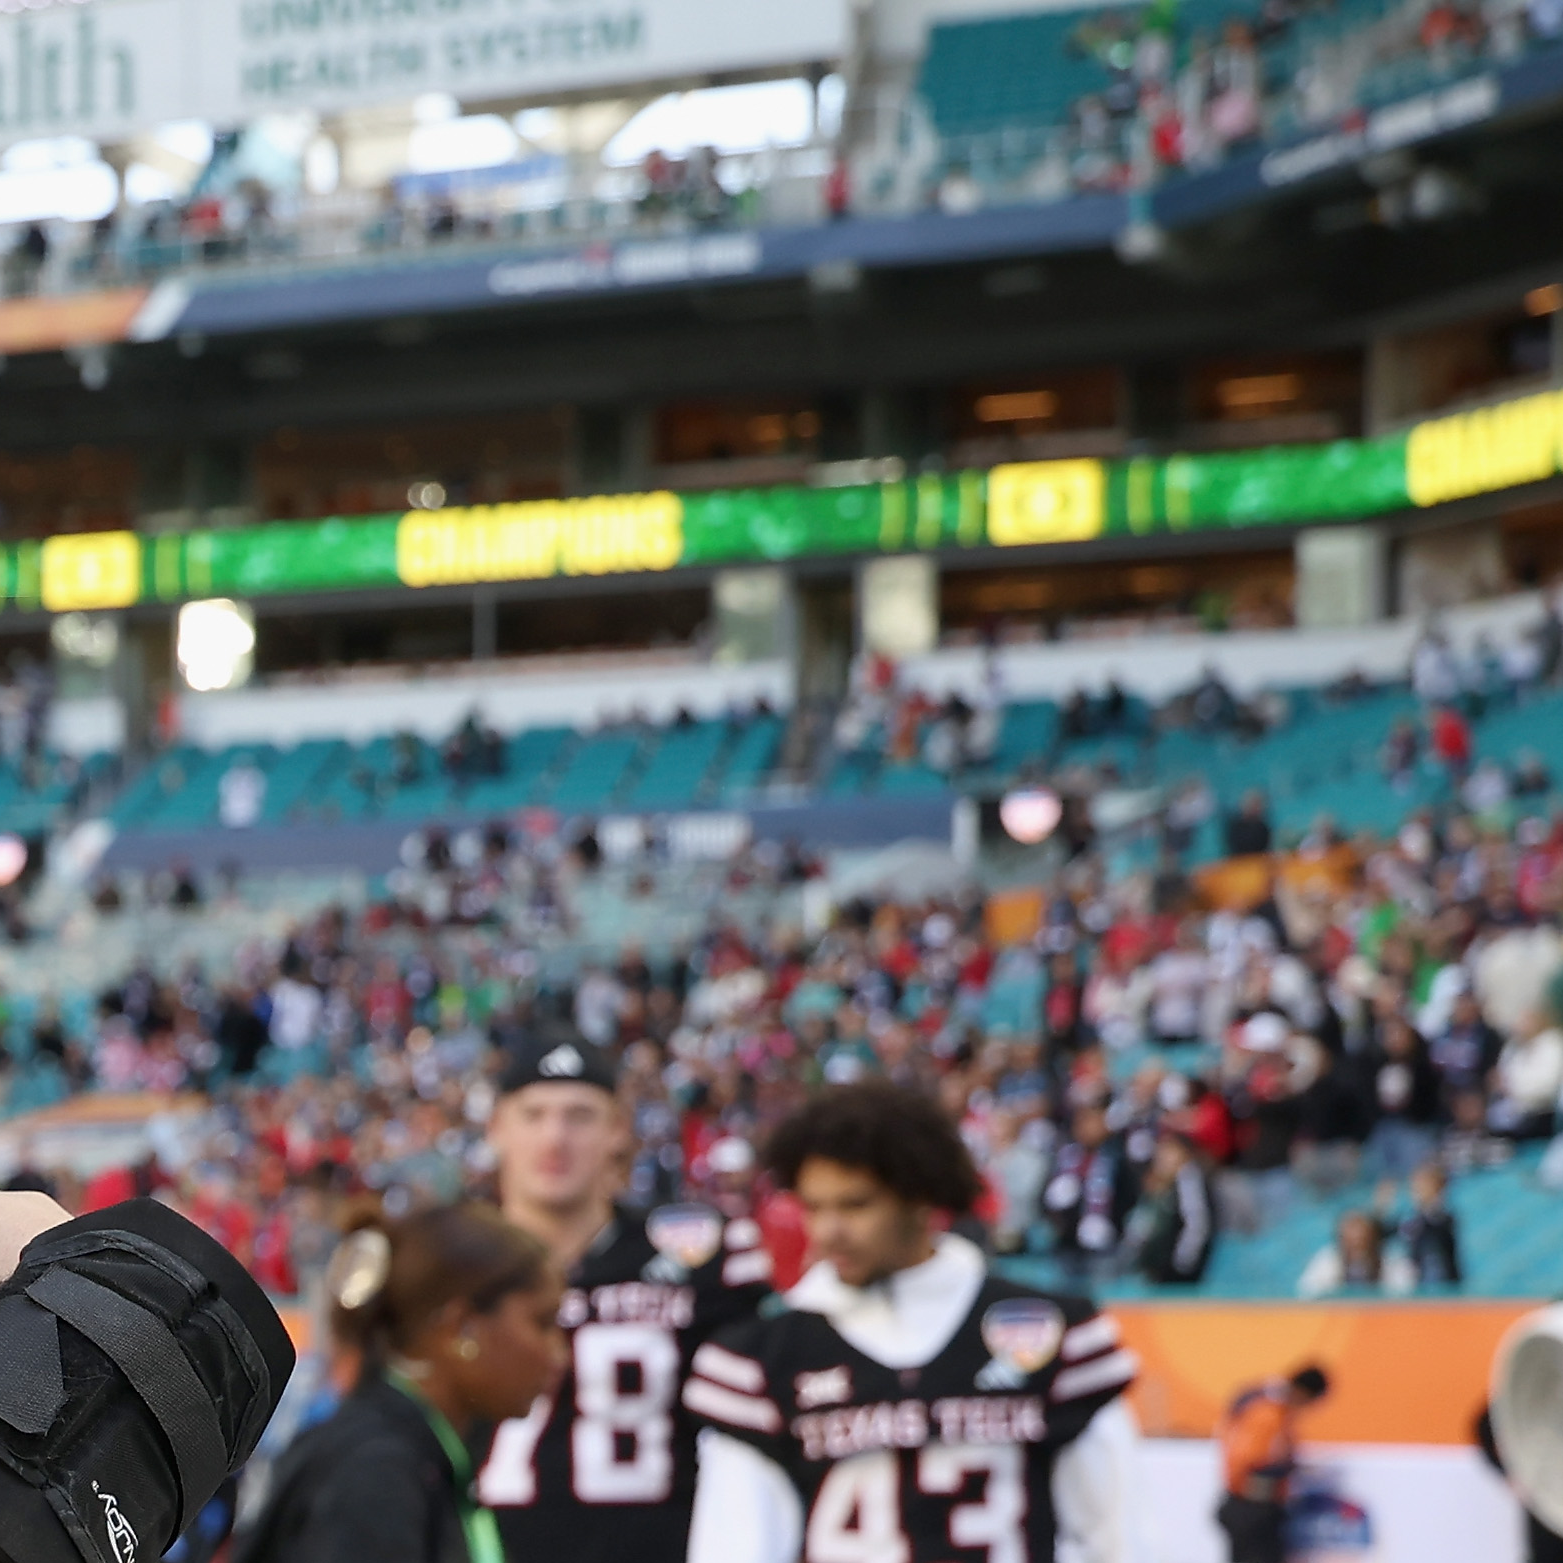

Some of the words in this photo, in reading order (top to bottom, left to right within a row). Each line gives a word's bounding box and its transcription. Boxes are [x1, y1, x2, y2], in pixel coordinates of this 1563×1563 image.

[396, 490, 682, 588] CHAMPIONS
[477, 1322, 681, 1506] 78
[790, 1400, 929, 1461] TEXAS
[930, 1396, 1047, 1446] TECH
